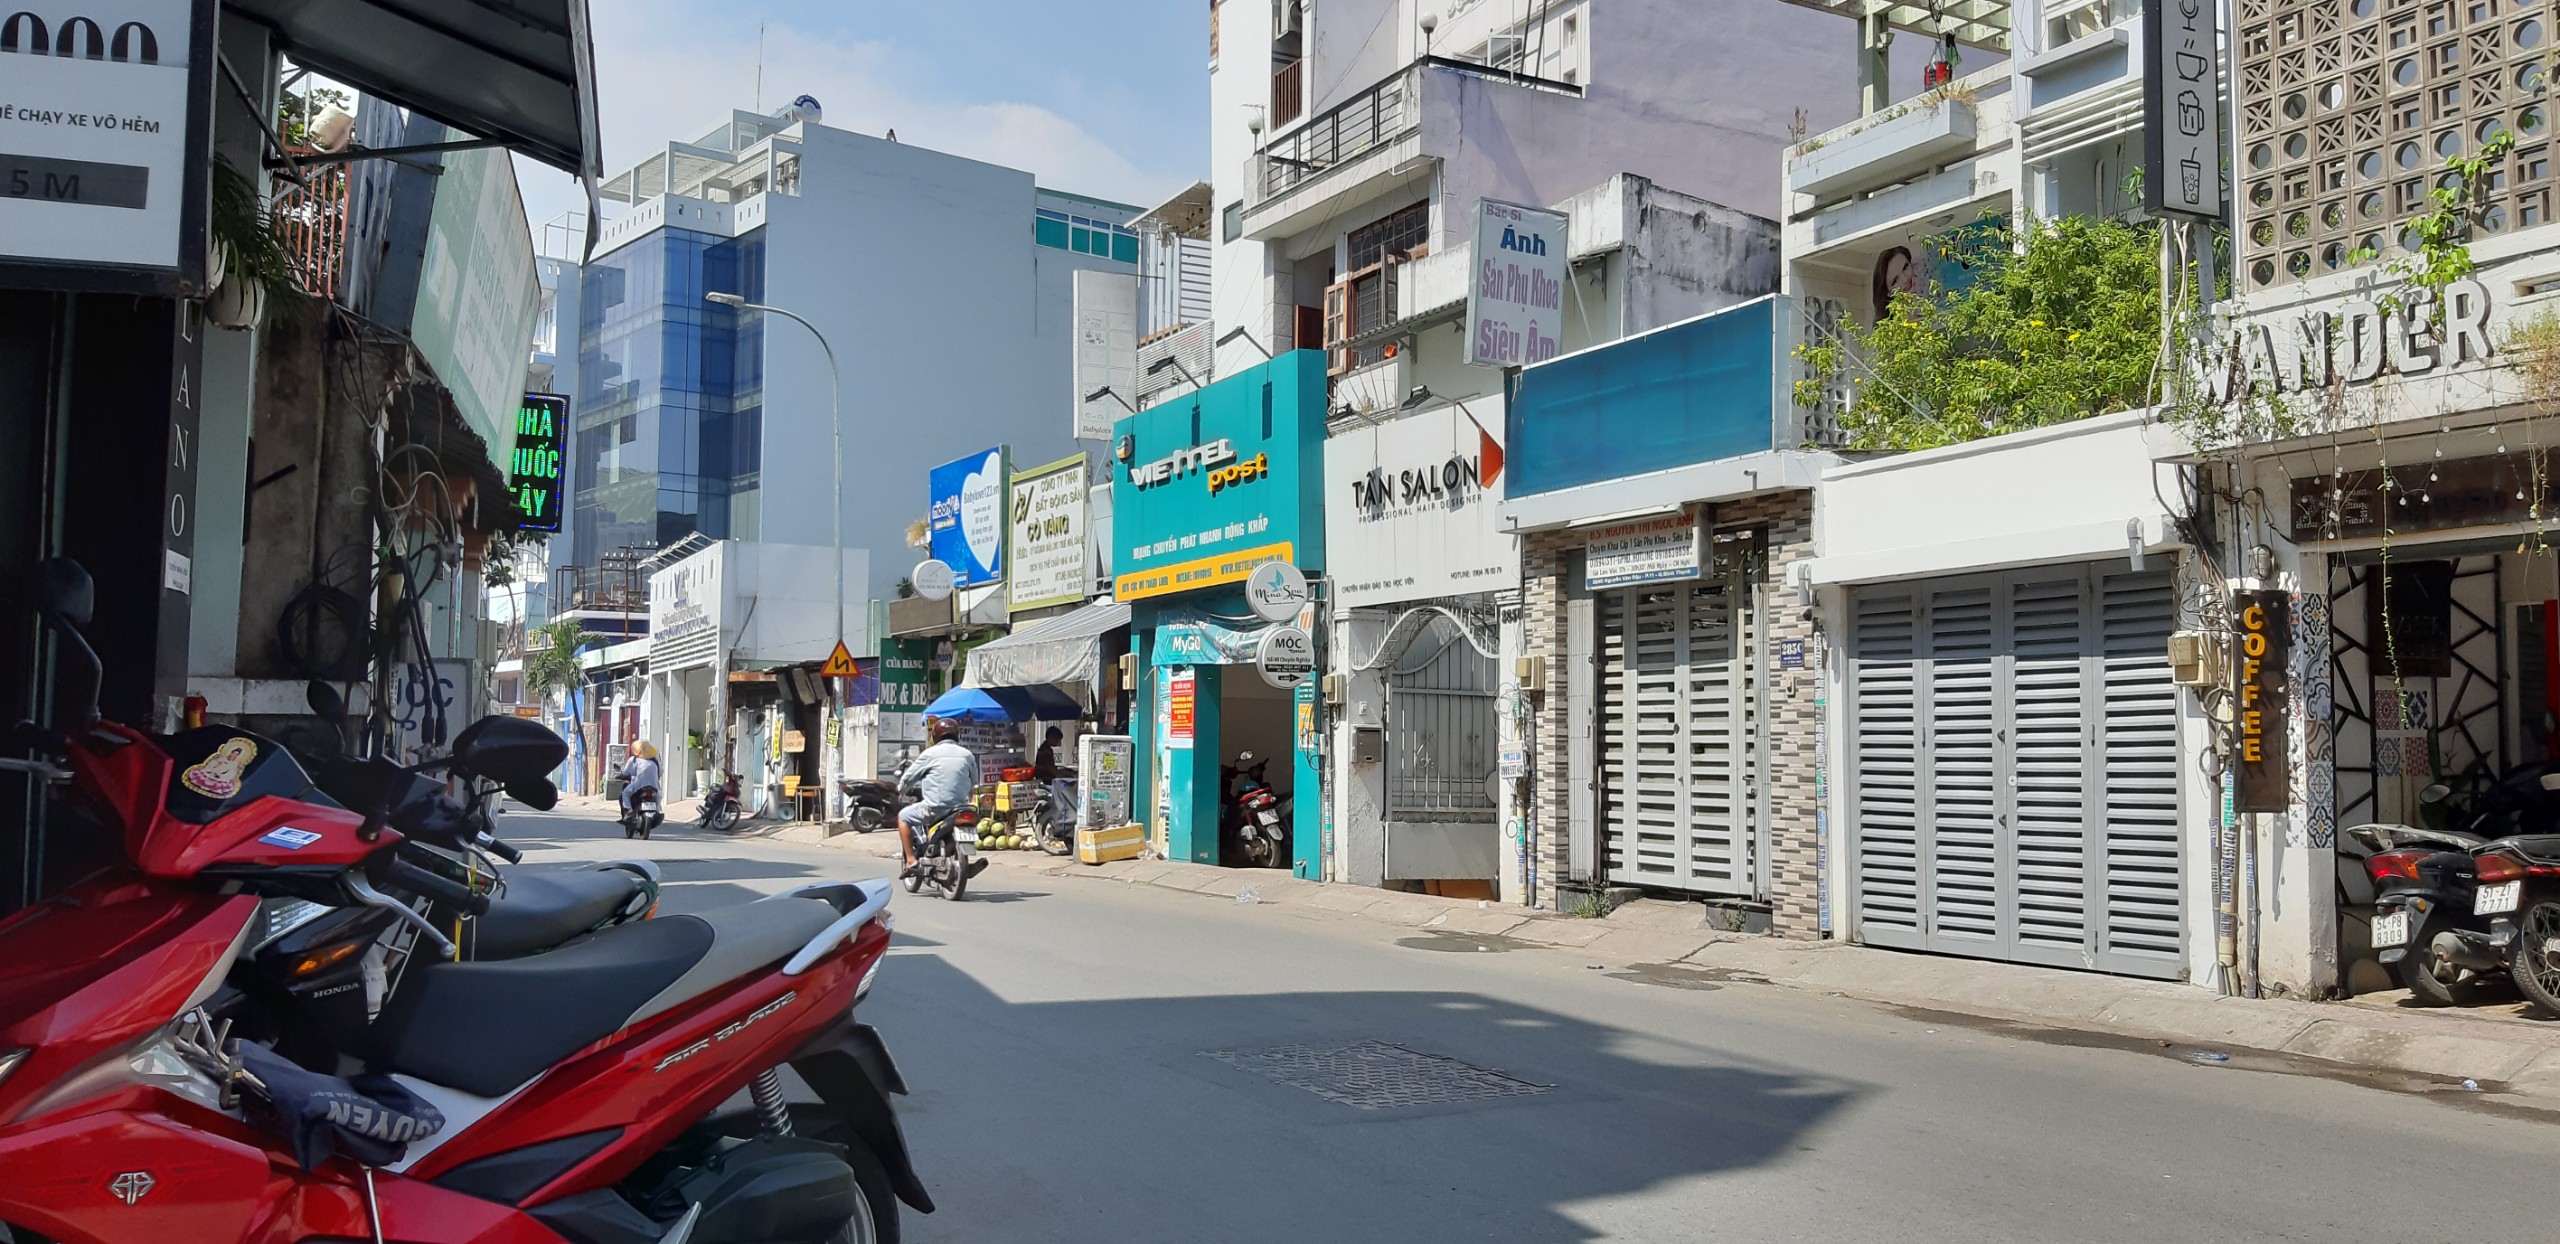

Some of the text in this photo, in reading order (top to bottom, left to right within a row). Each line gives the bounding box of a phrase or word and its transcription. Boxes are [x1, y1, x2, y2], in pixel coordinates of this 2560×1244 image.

[18, 108, 63, 126] CHẠY
[67, 113, 87, 127] XE
[93, 114, 117, 129] VÔ
[122, 115, 160, 134] HẺM
[11, 169, 80, 200] 5 M
[1500, 224, 1547, 257] Ánh
[1482, 257, 1559, 313] Sản Phụ Khoa
[1480, 319, 1555, 365] Siêu Âm
[2188, 280, 2496, 402] WANDER
[1131, 438, 1235, 487] VIETTEL
[1208, 452, 1267, 492] post
[1352, 455, 1479, 509] TÂN SALON
[1358, 494, 1483, 524] PROFESSIONAL HAIR DESIGNER
[1043, 513, 1070, 539] VÀNG
[1133, 512, 1269, 561] MẠNG CHUYỂN PHÁT NHANH RỘNG KHẮP
[1255, 584, 1305, 603] Mina Spa
[1781, 642, 1803, 656] 285C
[880, 675, 928, 711] MẸ & BÉ
[2242, 606, 2266, 762] COFFEE
[2481, 897, 2510, 911] 2771
[2376, 915, 2403, 930] 54-P8
[2376, 929, 2403, 945] 8309
[313, 982, 360, 998] HONDA
